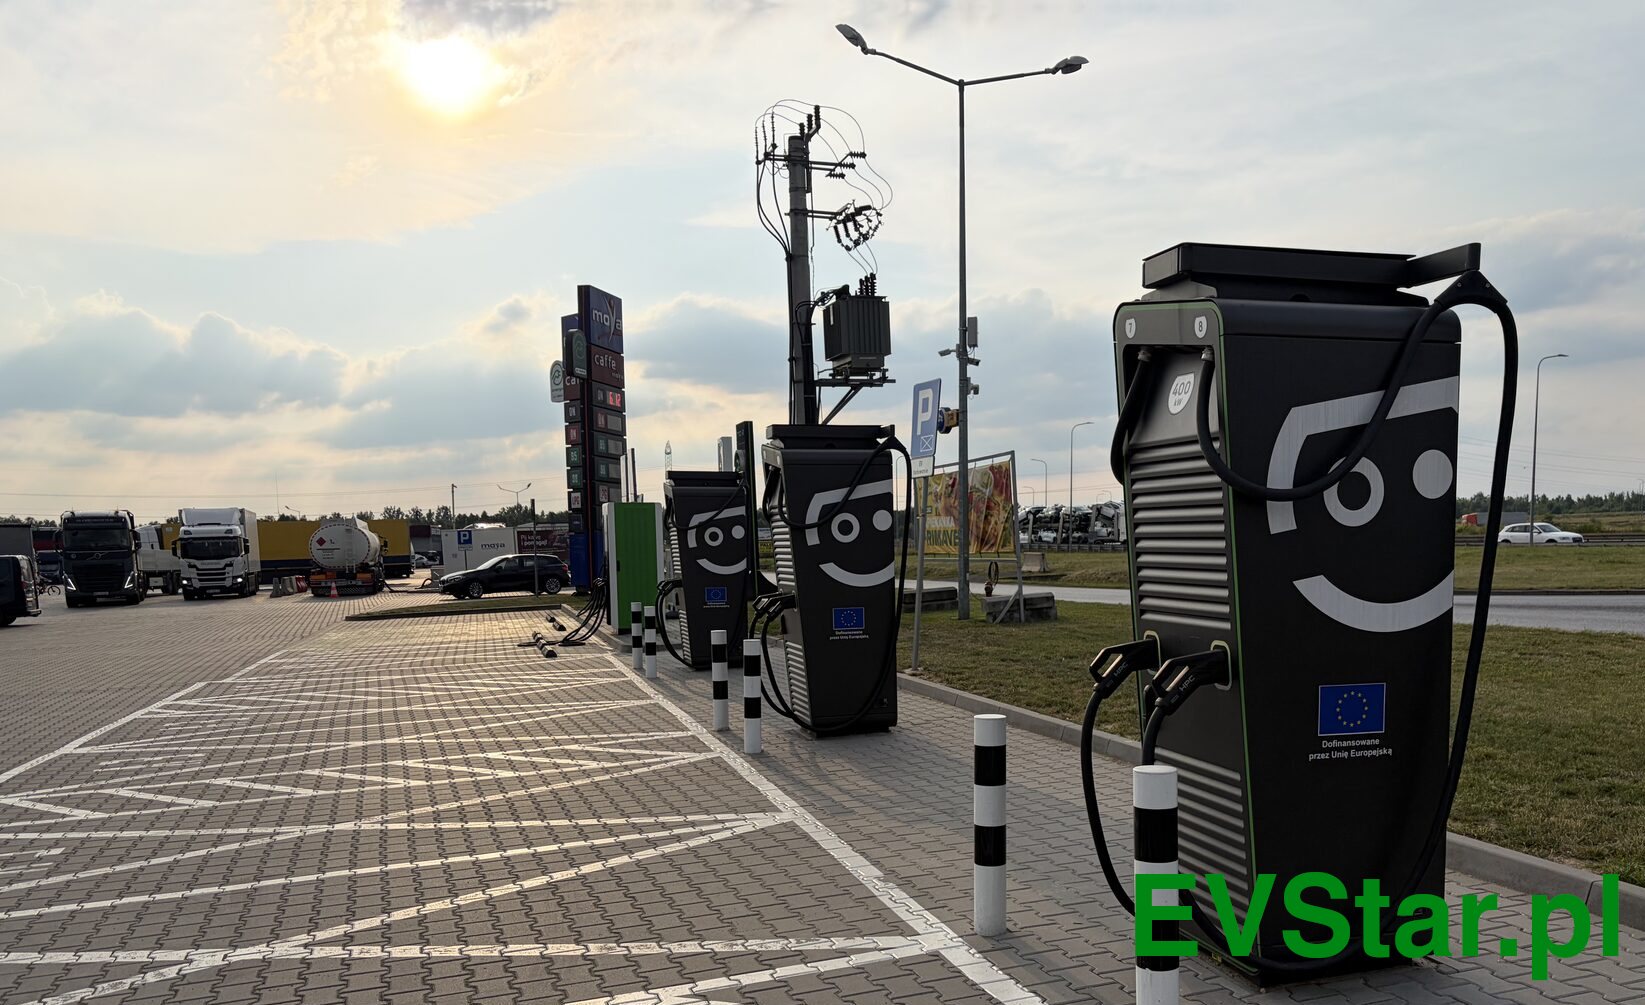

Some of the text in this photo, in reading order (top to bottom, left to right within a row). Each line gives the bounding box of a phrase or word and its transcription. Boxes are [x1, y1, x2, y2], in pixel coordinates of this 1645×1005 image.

[1128, 322, 1133, 334] 7
[1197, 320, 1204, 333] 8
[594, 353, 617, 371] caffe
[1172, 380, 1192, 397] 400
[917, 388, 934, 436] P
[460, 531, 469, 543] P
[1113, 660, 1129, 678] HPC
[1178, 674, 1196, 692] HPC
[1321, 738, 1380, 749] Dofinansowane
[1308, 746, 1393, 762] przez Unię Europejską
